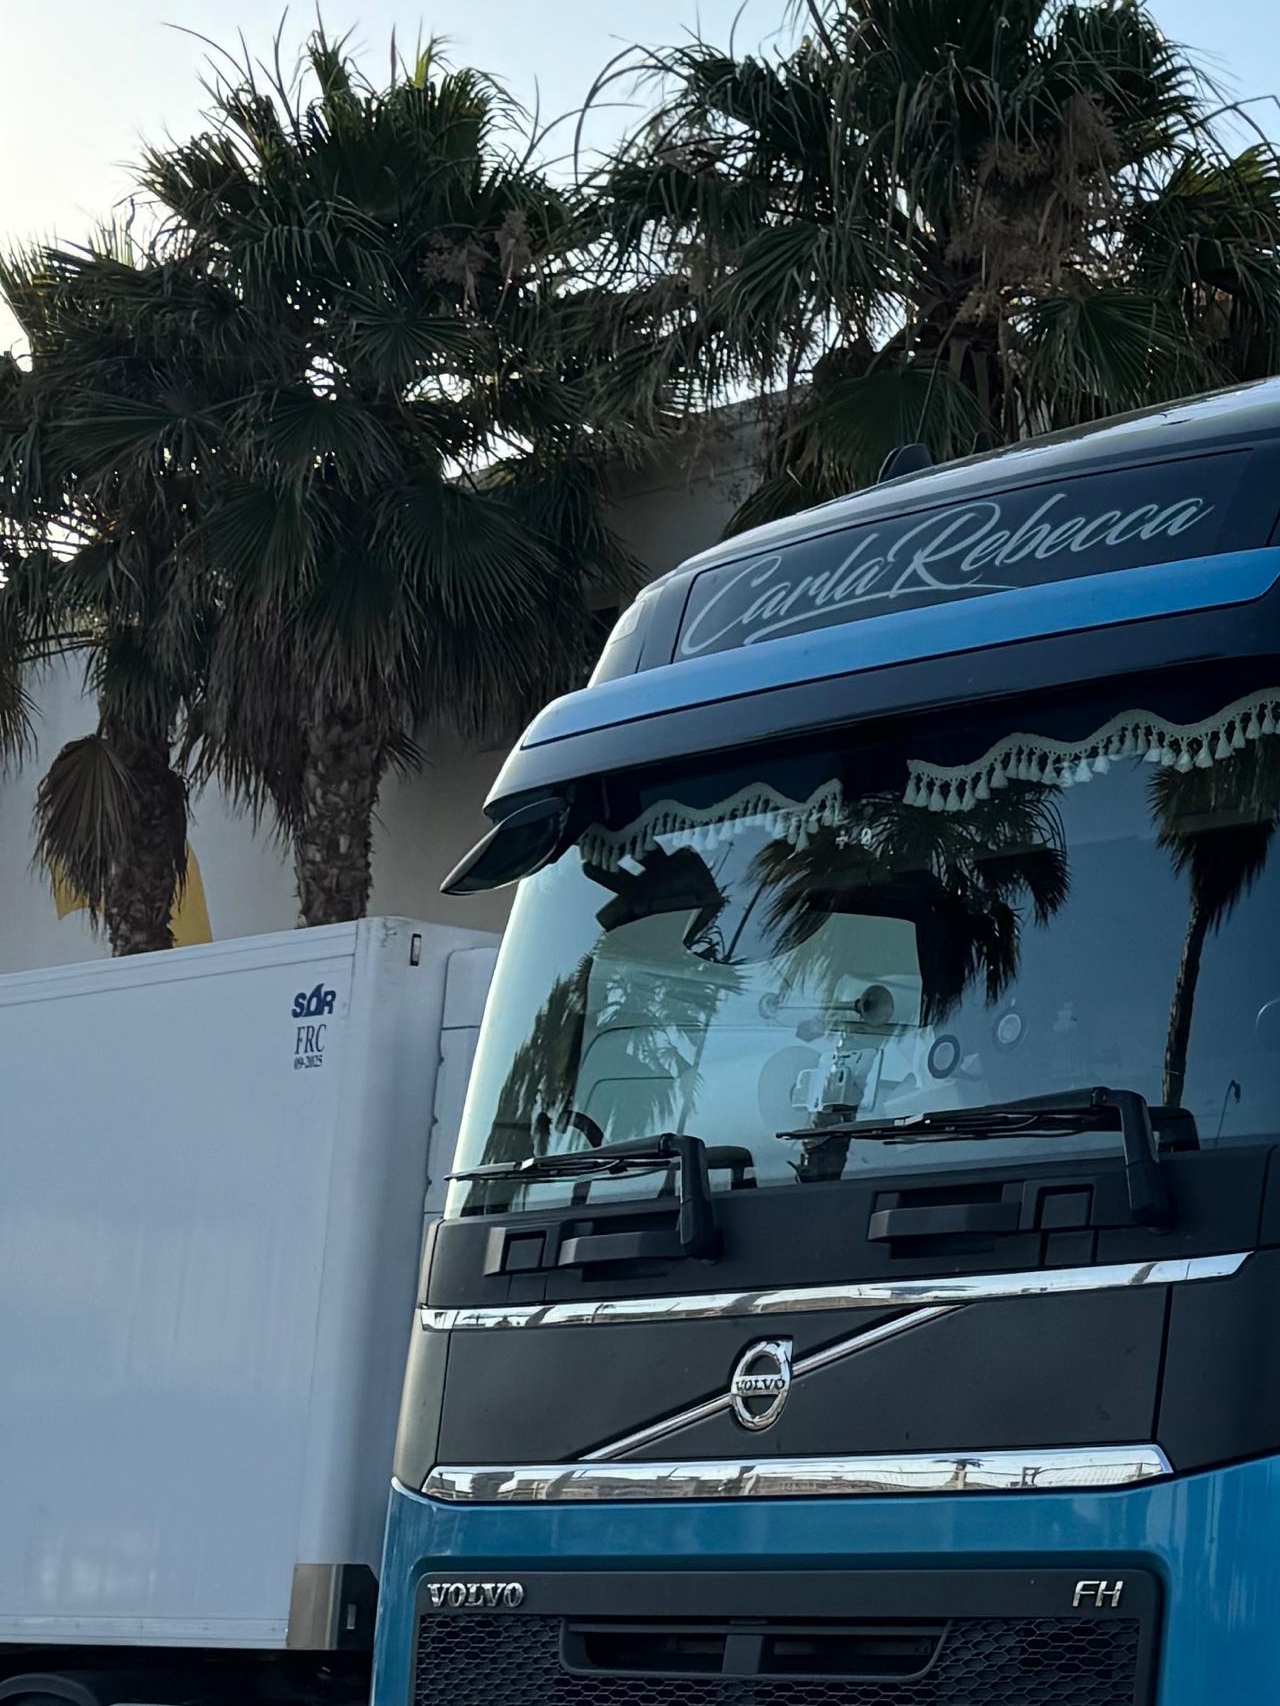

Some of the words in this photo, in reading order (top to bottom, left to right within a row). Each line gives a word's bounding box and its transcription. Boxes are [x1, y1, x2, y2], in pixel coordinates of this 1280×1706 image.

[680, 533, 892, 655] Carla
[882, 489, 1214, 599] Rebecca
[294, 1023, 327, 1054] FRC
[735, 1378, 786, 1391] VOLVO
[427, 1582, 524, 1608] VOLVO
[1072, 1580, 1124, 1607] FH
